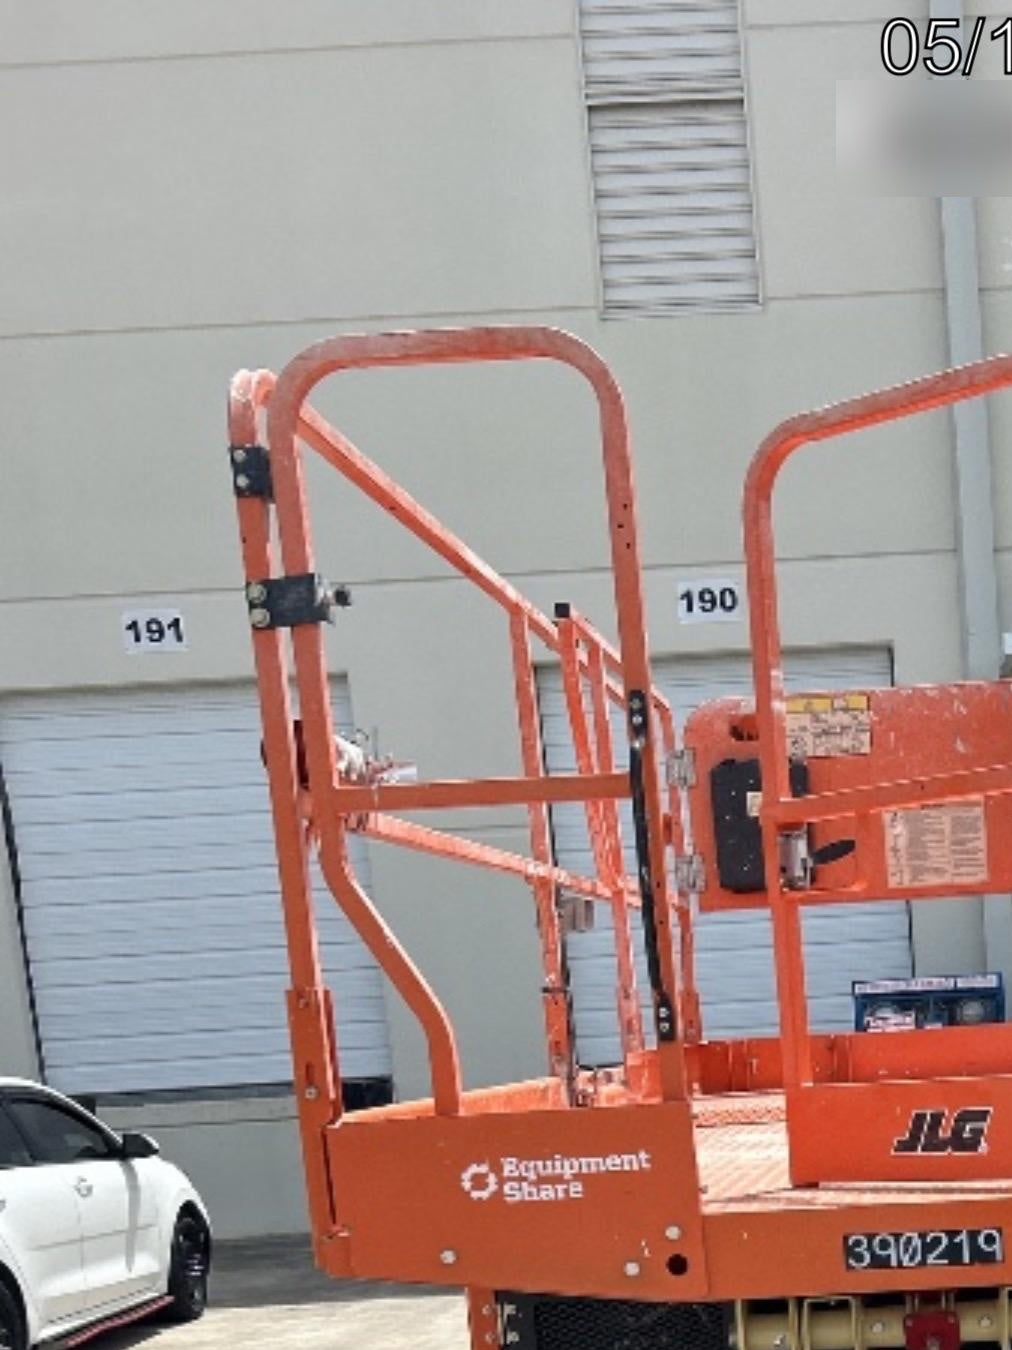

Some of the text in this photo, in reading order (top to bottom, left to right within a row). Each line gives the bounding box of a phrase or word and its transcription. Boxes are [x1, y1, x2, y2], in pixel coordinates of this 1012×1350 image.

[680, 587, 738, 613] 190
[125, 617, 184, 643] 191
[890, 1106, 993, 1156] JLG
[501, 1149, 652, 1181] Equipment
[503, 1180, 584, 1204] Share
[847, 1228, 1004, 1268] 390219
